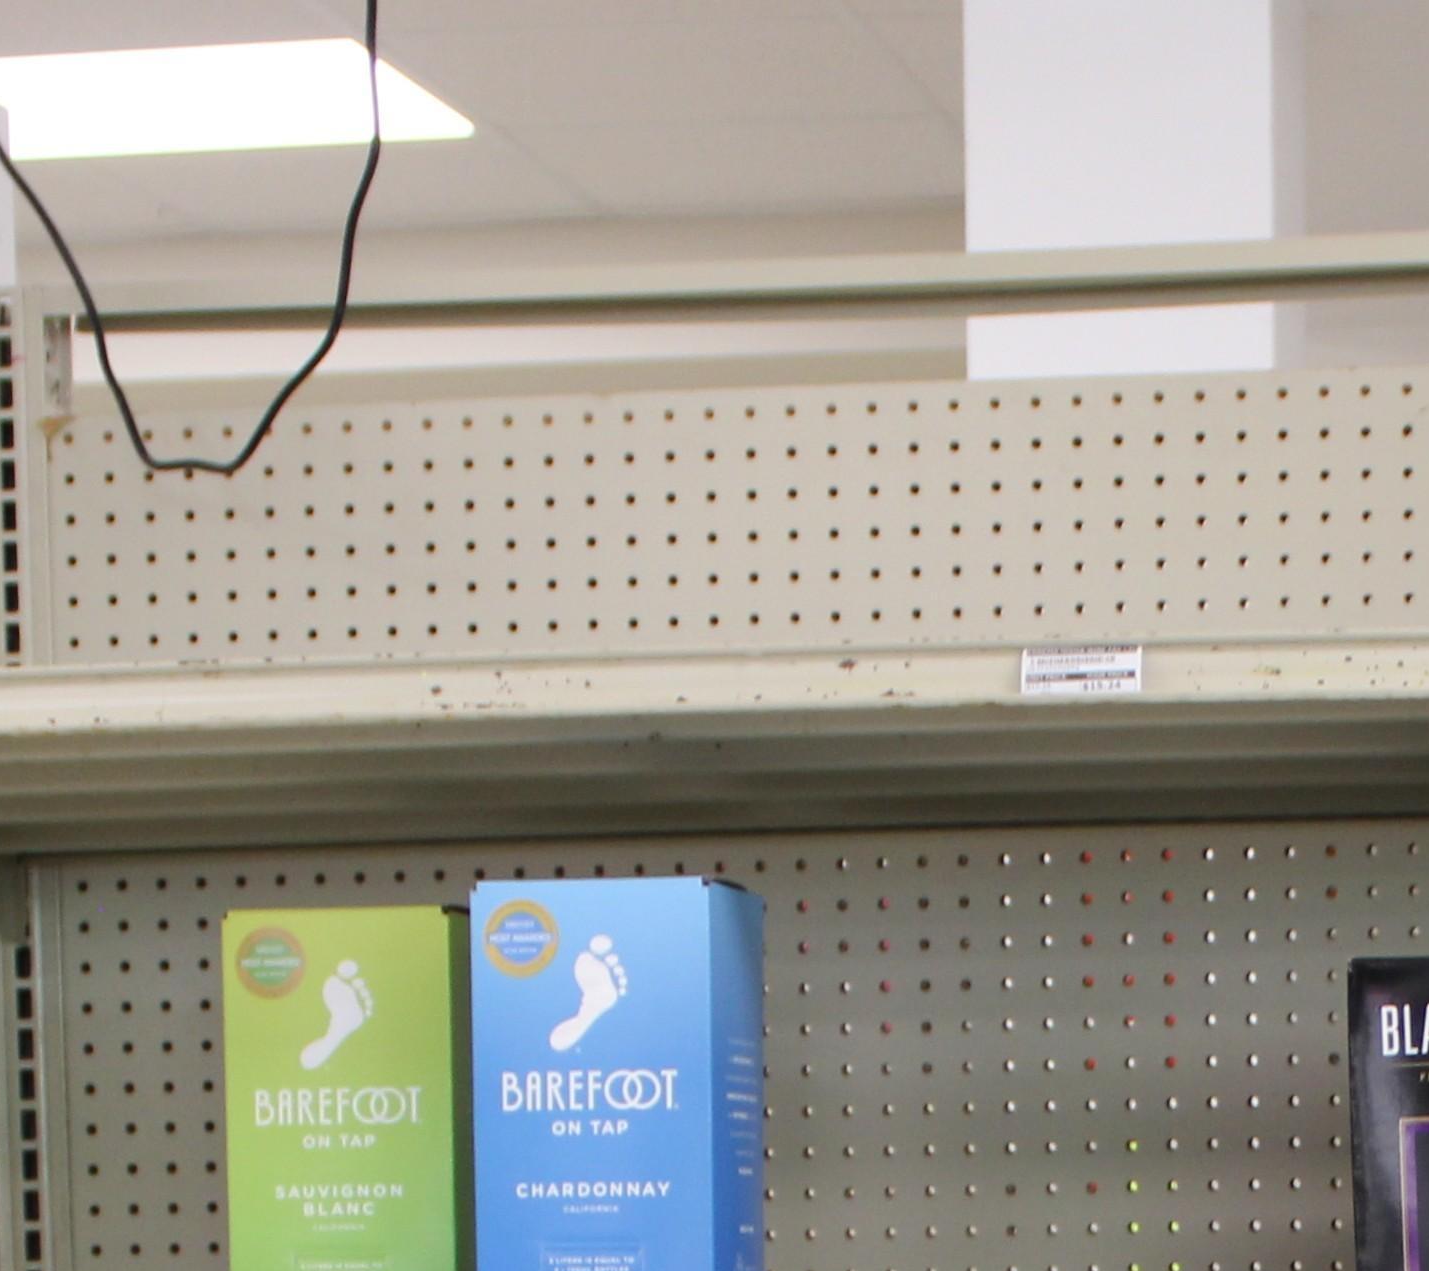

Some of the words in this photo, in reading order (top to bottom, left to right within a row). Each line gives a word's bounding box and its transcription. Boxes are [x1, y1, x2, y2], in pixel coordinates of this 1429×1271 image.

[502, 1069, 679, 1112] BAREFOOT
[254, 1087, 422, 1127] BAREFOOT
[551, 1121, 581, 1136] ON
[590, 1119, 628, 1135] TAP
[303, 1134, 330, 1148] ON
[340, 1133, 376, 1147] TAP
[275, 1184, 404, 1200] SAUVIGNON
[516, 1181, 670, 1198] CHARDONNAY
[303, 1202, 375, 1217] BLANC
